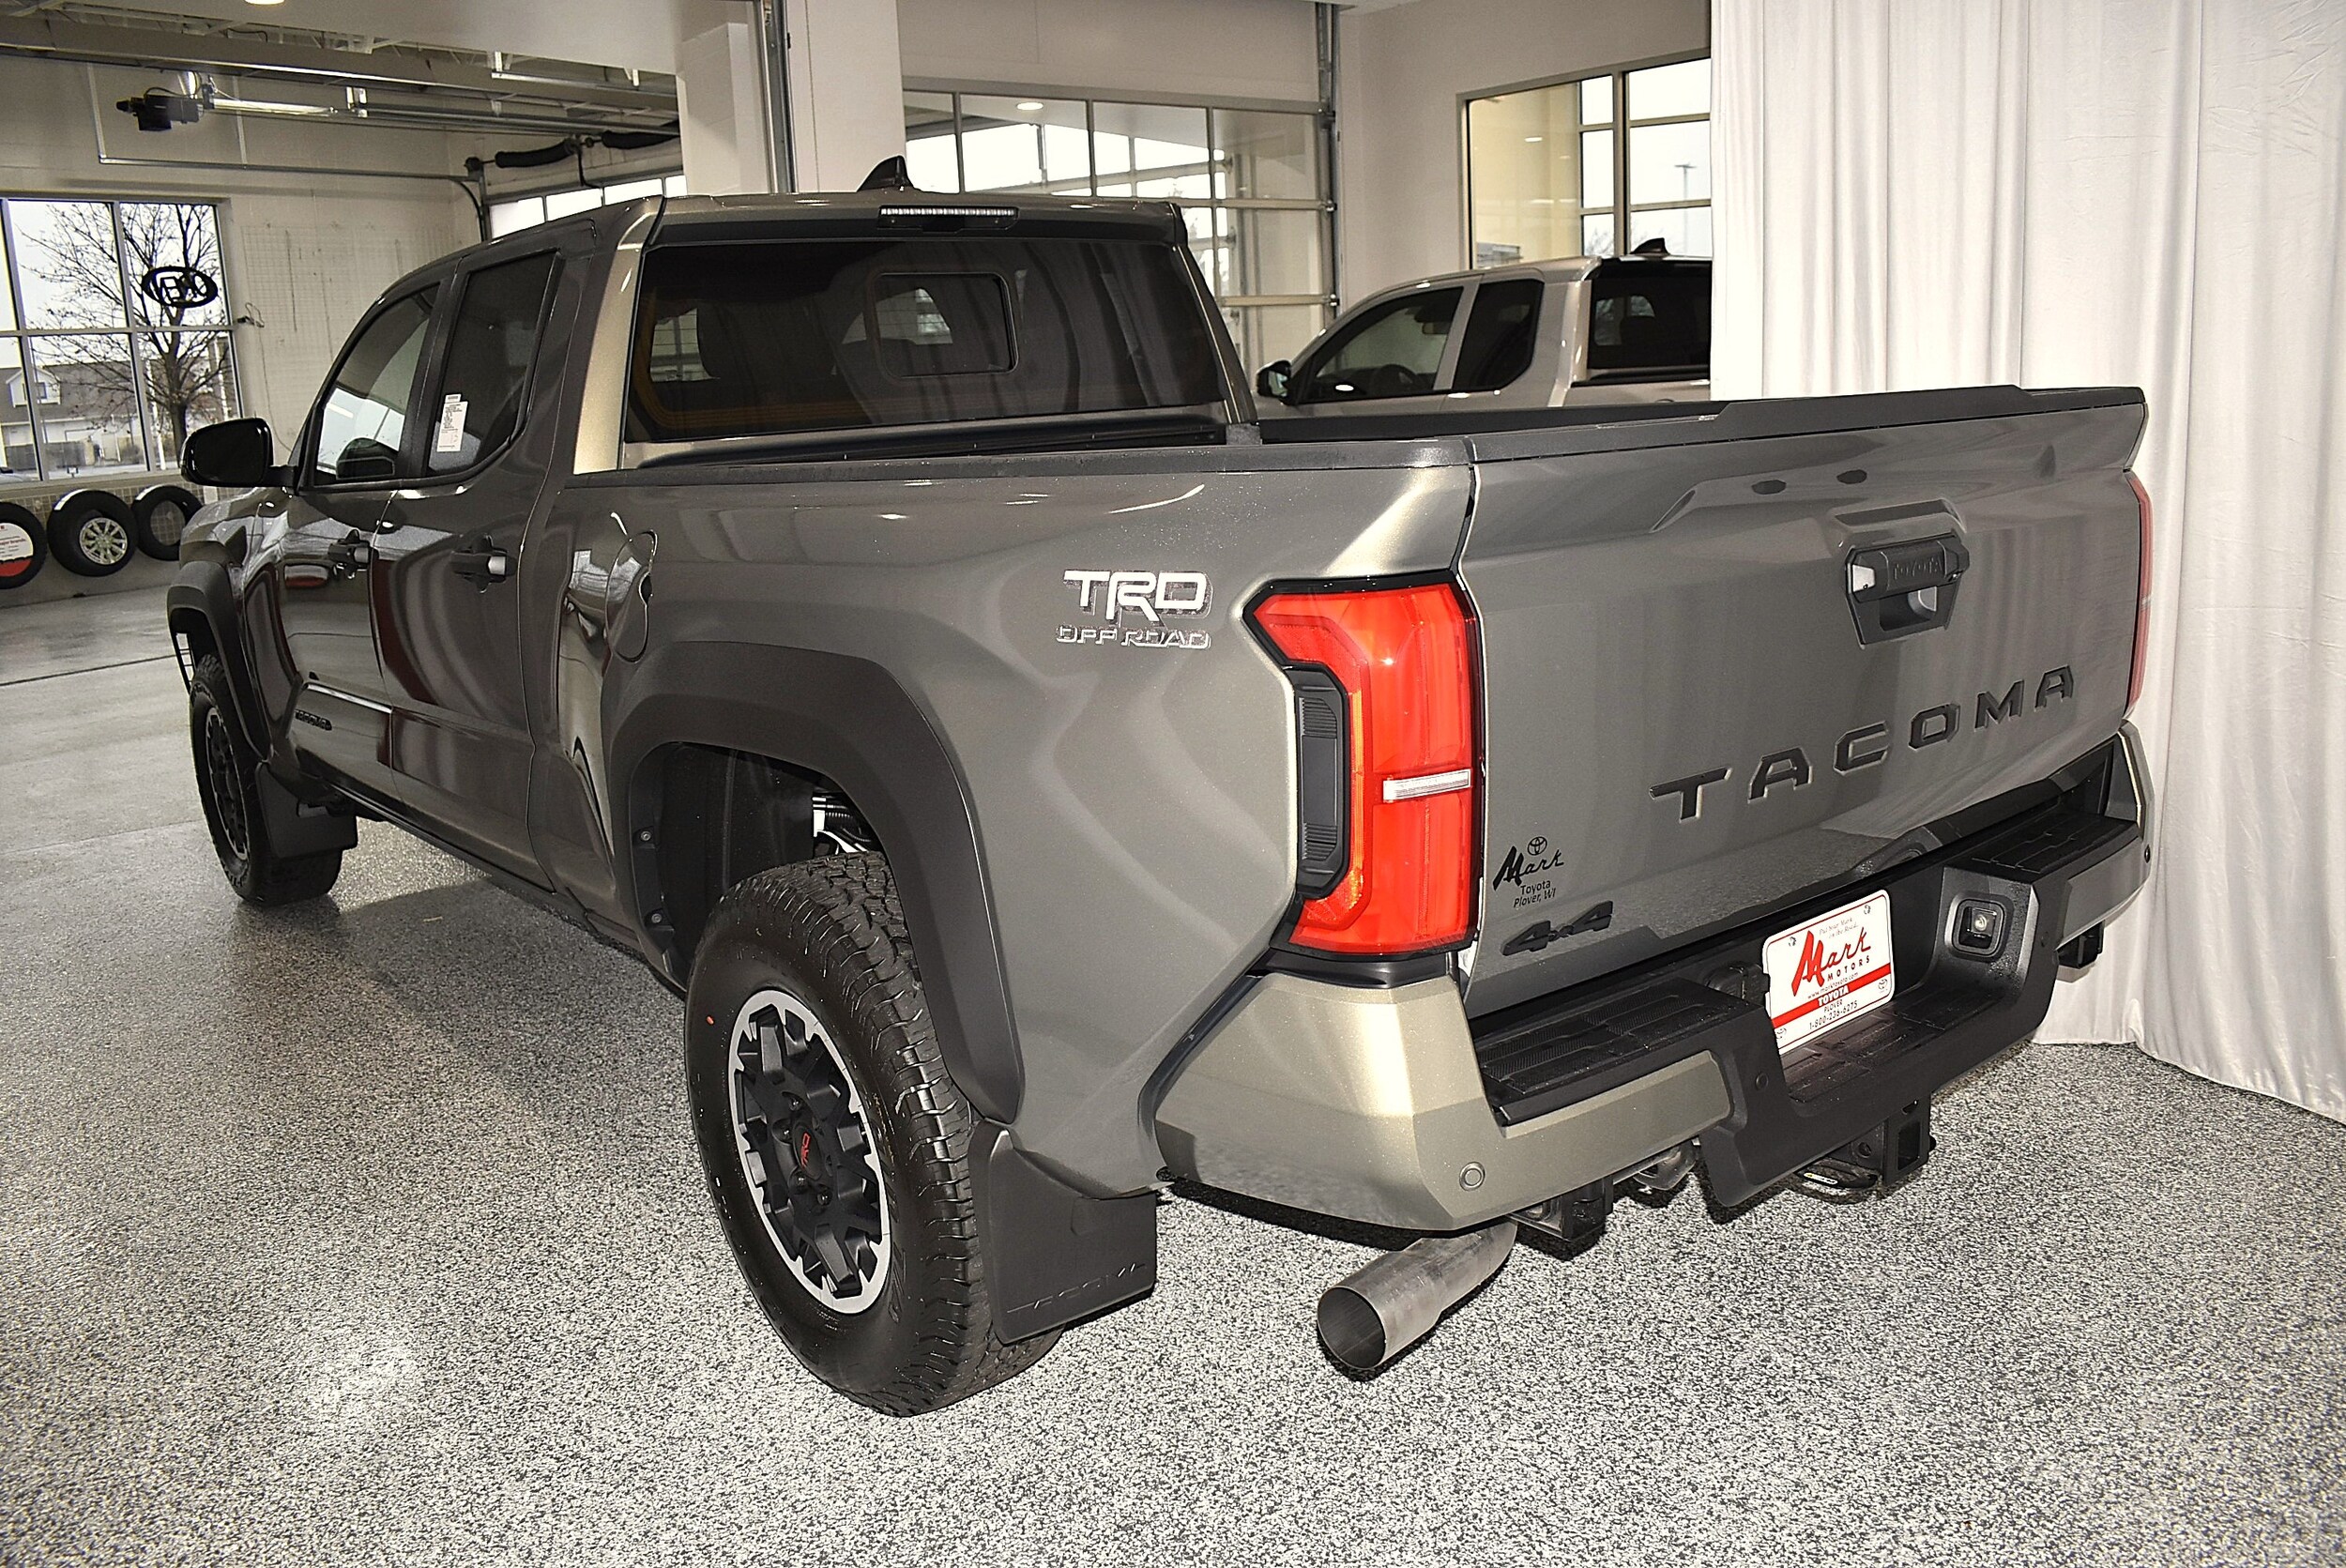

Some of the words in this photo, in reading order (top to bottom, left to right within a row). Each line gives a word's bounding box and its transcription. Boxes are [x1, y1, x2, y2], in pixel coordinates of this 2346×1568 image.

[1063, 570, 1212, 623] TRD
[1056, 626, 1117, 646] OFF
[1121, 630, 1211, 649] ROAD
[1649, 664, 2074, 824] TACOMA
[1492, 845, 1564, 891] Mark
[1513, 893, 1542, 908] Plover,
[1544, 888, 1557, 900] WI
[1520, 880, 1551, 895] Toyota
[1501, 900, 1614, 956] 4x4
[1791, 926, 1871, 997] Mark
[1827, 955, 1870, 982] MOTORS
[1818, 984, 1850, 1007] TOYOTA
[1823, 998, 1843, 1013] PLOVER
